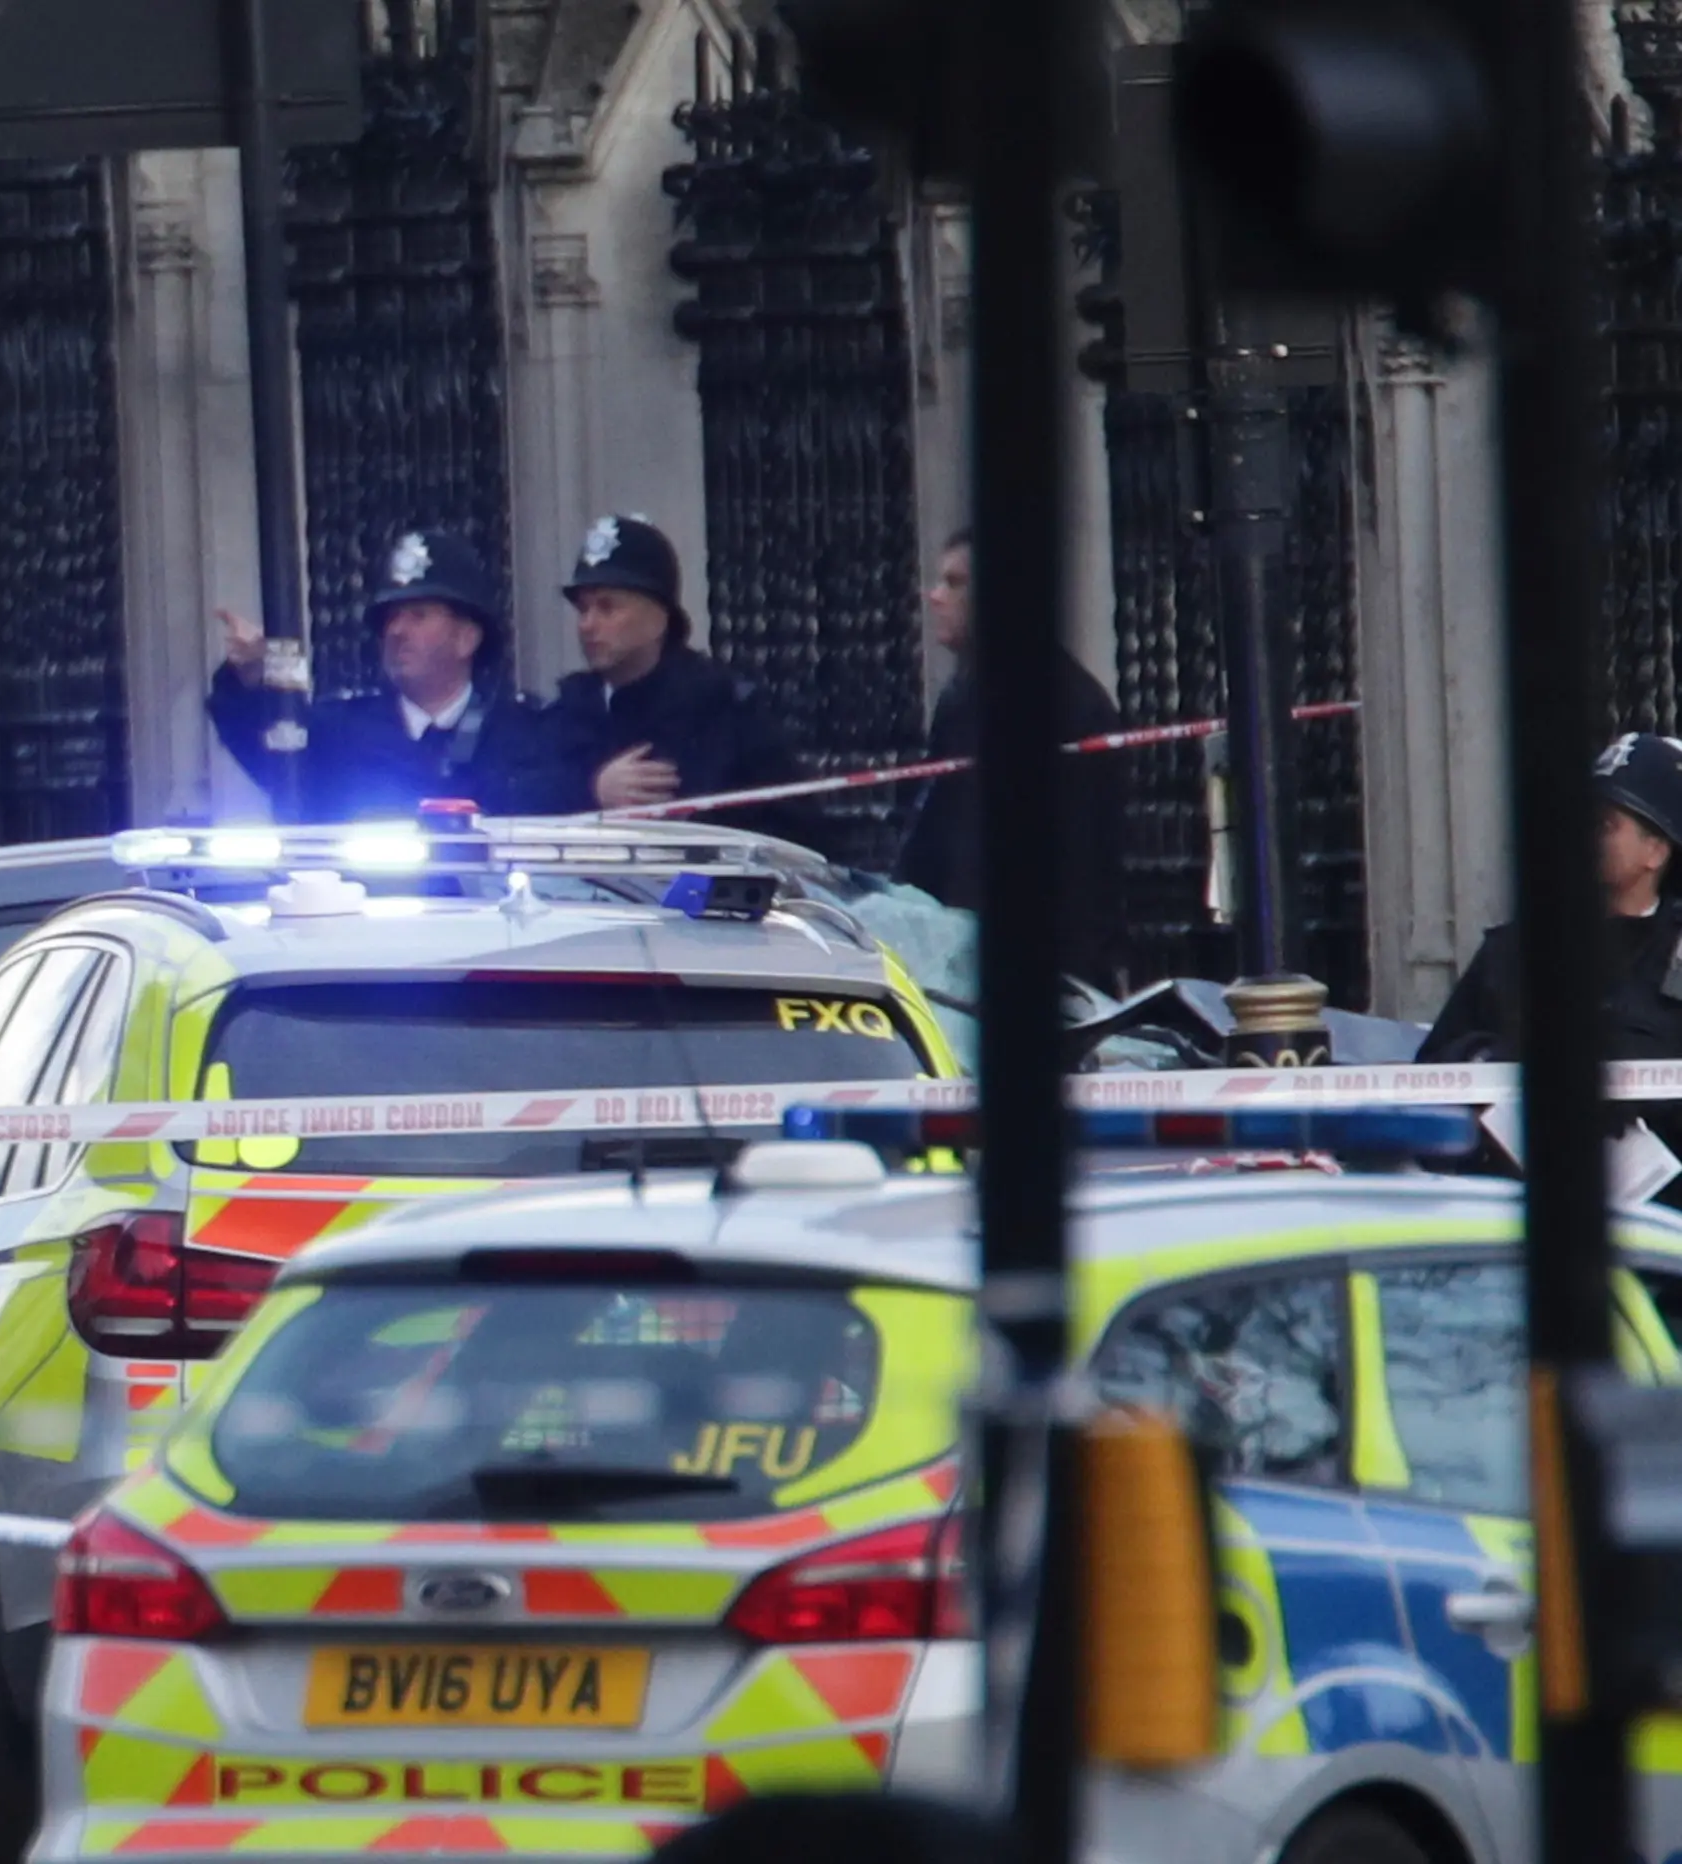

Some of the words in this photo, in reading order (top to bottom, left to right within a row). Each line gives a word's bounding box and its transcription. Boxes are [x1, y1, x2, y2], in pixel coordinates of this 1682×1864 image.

[775, 998, 895, 1041] FXQ
[673, 1424, 816, 1478] JFU
[343, 1655, 470, 1713] BV16
[492, 1656, 601, 1712] UYA
[220, 1763, 699, 1803] POLICE
